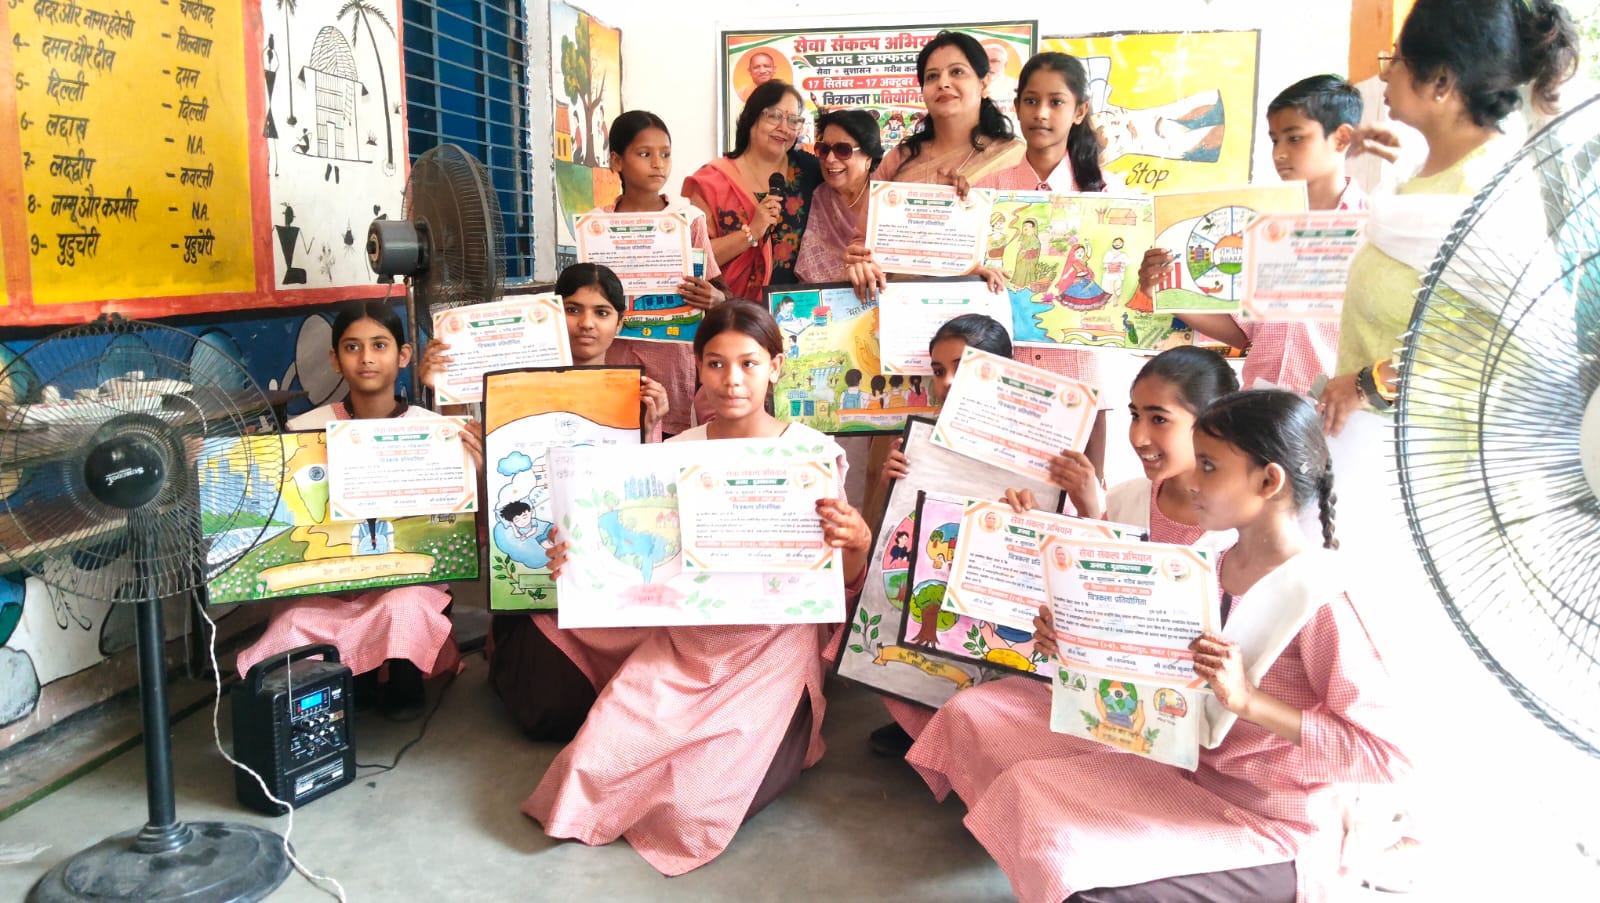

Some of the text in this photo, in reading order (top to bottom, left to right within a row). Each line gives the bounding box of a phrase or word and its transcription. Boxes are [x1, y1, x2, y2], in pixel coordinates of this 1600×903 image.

[793, 33, 936, 53] सेवा संकल्प अभिय
[815, 53, 918, 66] जनपद मुजफ्फरन
[176, 66, 201, 90] दमन
[816, 67, 831, 76] सेवा
[47, 67, 90, 106] दिल्ली
[808, 80, 819, 89] 17
[823, 77, 854, 89] सितंबर
[866, 78, 877, 88] 17
[823, 89, 925, 106] चित्रकला प्रतियोगित
[178, 95, 210, 125] दिल्ली
[46, 113, 90, 146] लद्दाख
[1125, 162, 1170, 188] Stop
